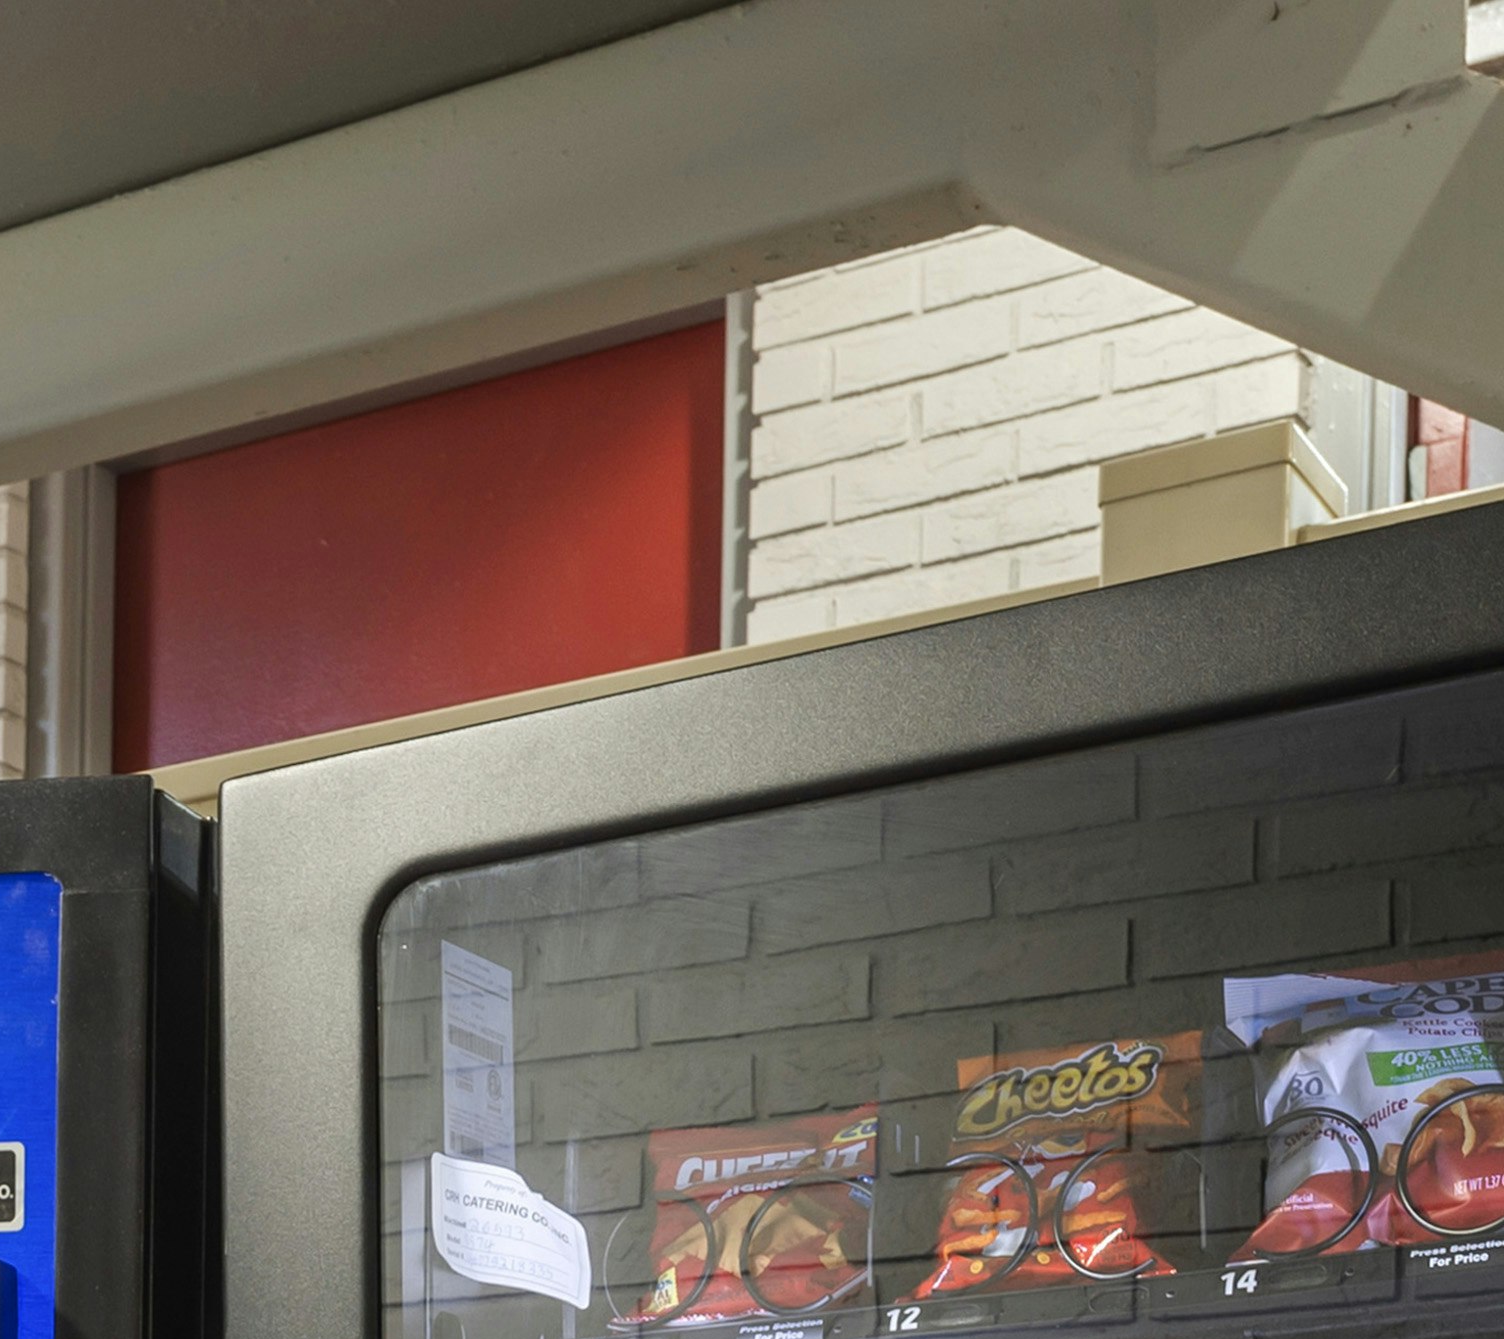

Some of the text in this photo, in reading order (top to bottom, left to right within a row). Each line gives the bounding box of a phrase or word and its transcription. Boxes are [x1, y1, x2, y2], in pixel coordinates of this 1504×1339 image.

[1391, 1044, 1482, 1068] 40% LESS
[956, 1048, 1155, 1134] Cheetos
[1410, 1246, 1448, 1258] Press
[1428, 1250, 1489, 1268] For Price
[1221, 1269, 1258, 1296] 14
[886, 1306, 920, 1331] 12
